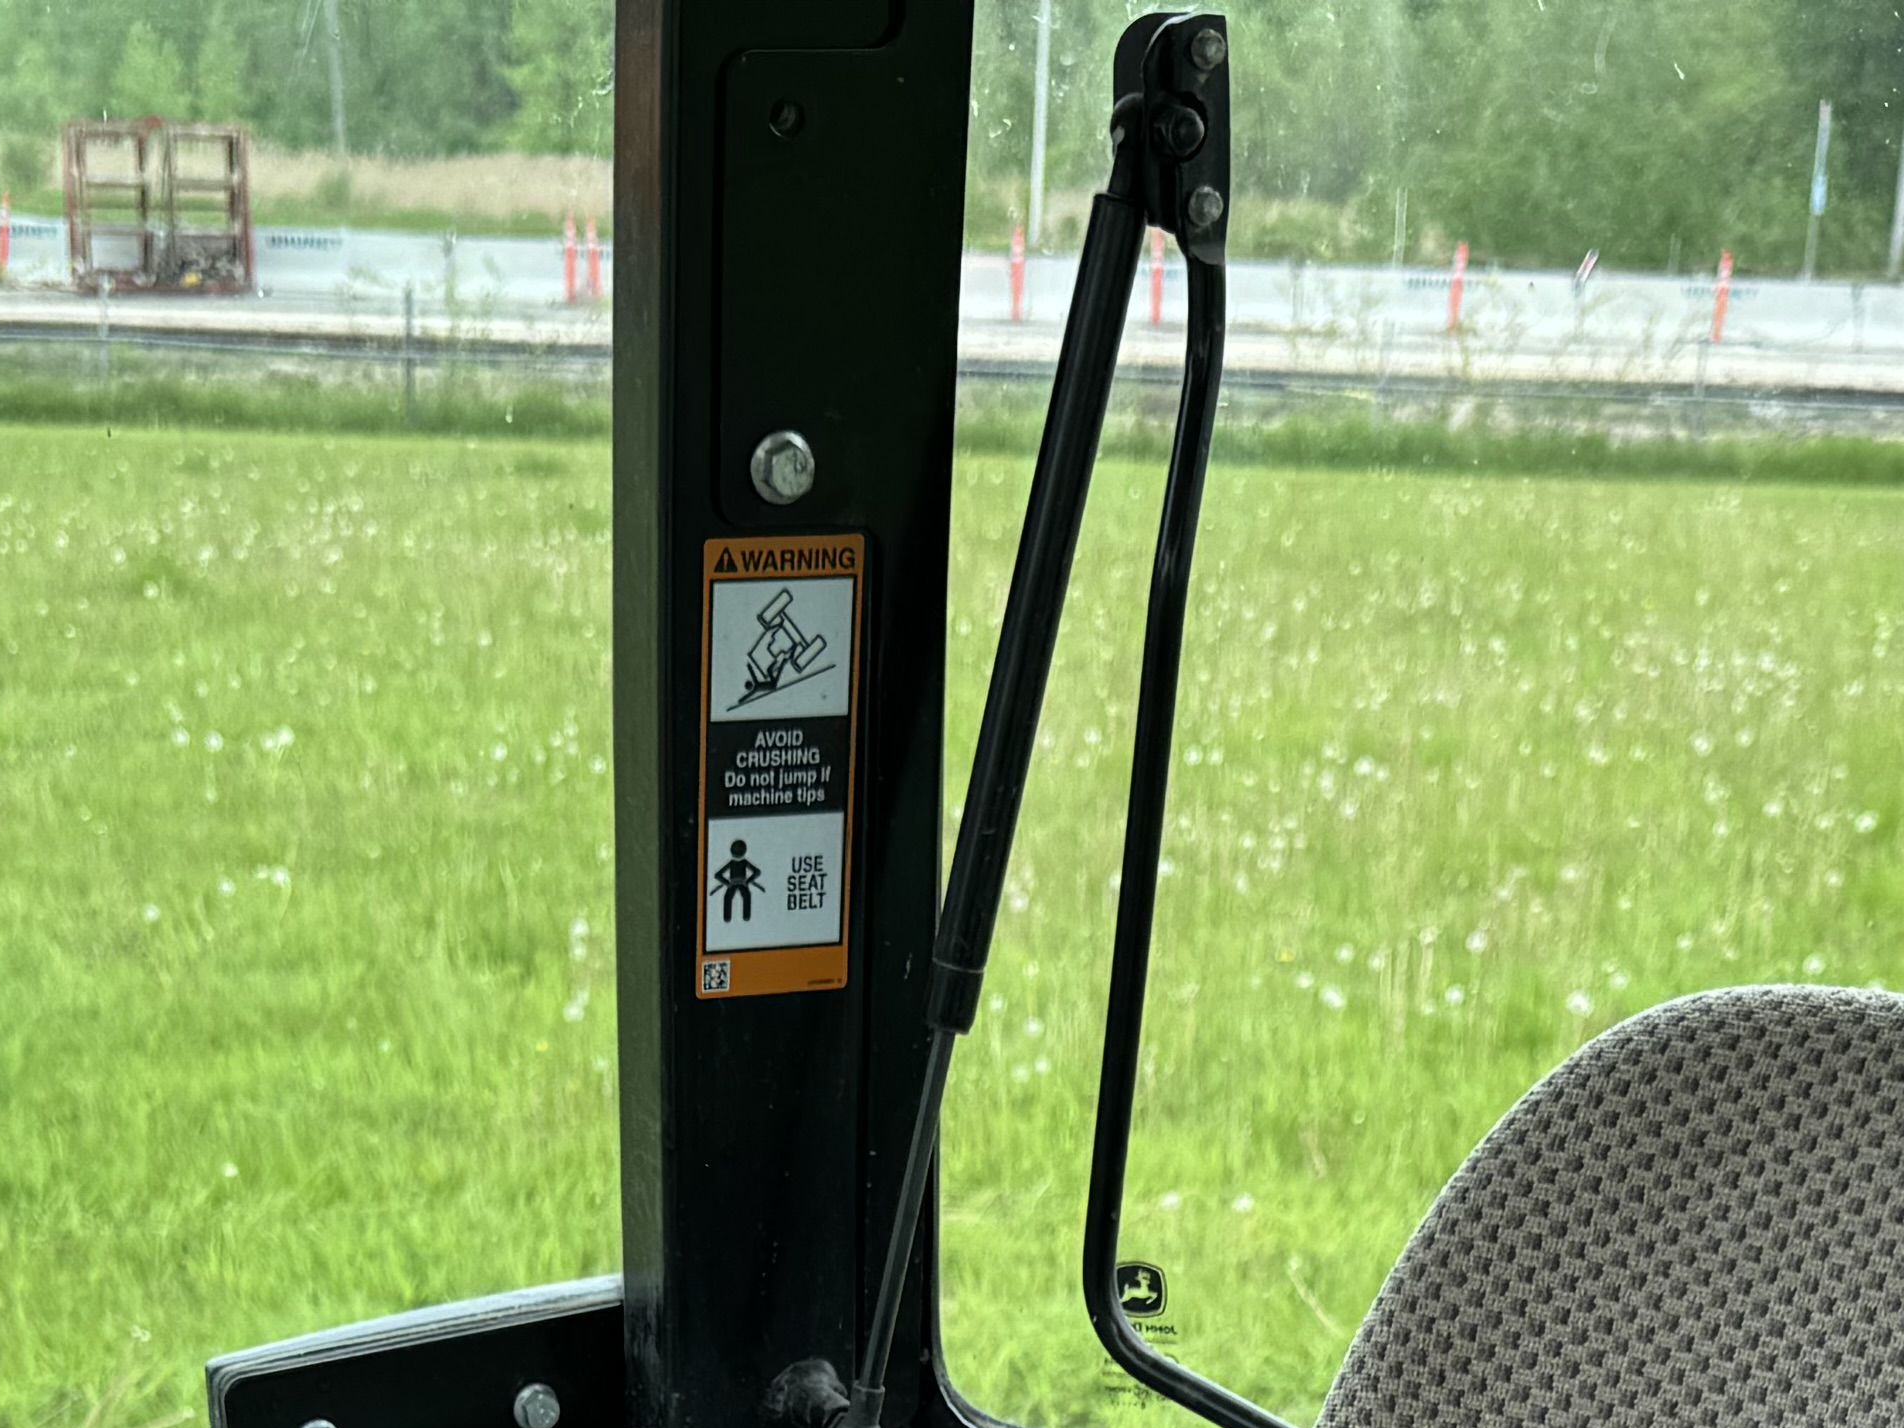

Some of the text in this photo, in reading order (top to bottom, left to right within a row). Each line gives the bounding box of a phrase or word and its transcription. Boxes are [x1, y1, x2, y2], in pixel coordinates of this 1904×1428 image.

[741, 547, 856, 573] WARNING
[754, 730, 803, 748] AVOID
[736, 748, 820, 768] CRUSHING
[725, 771, 746, 788] Do
[750, 770, 775, 786] not
[778, 768, 817, 790] jump
[729, 787, 825, 807] machine tips
[792, 856, 823, 873] USE
[787, 874, 827, 892] SEAT
[787, 892, 826, 910] BELT
